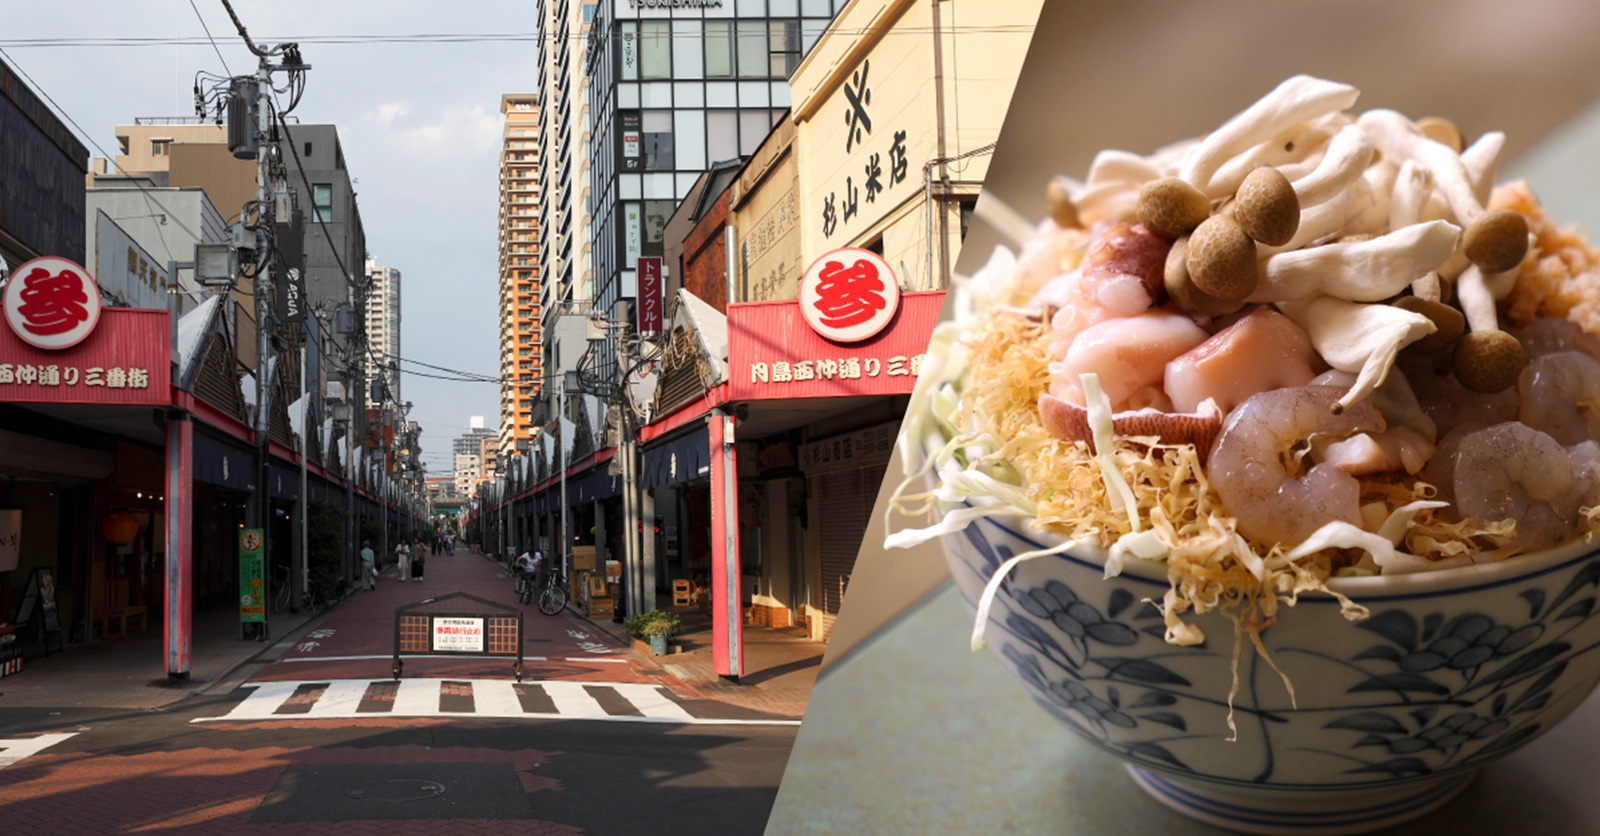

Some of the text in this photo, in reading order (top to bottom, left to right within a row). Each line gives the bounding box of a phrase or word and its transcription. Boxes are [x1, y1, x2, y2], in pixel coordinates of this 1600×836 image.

[823, 129, 908, 239] 杉山米店
[287, 283, 299, 317] AQUA
